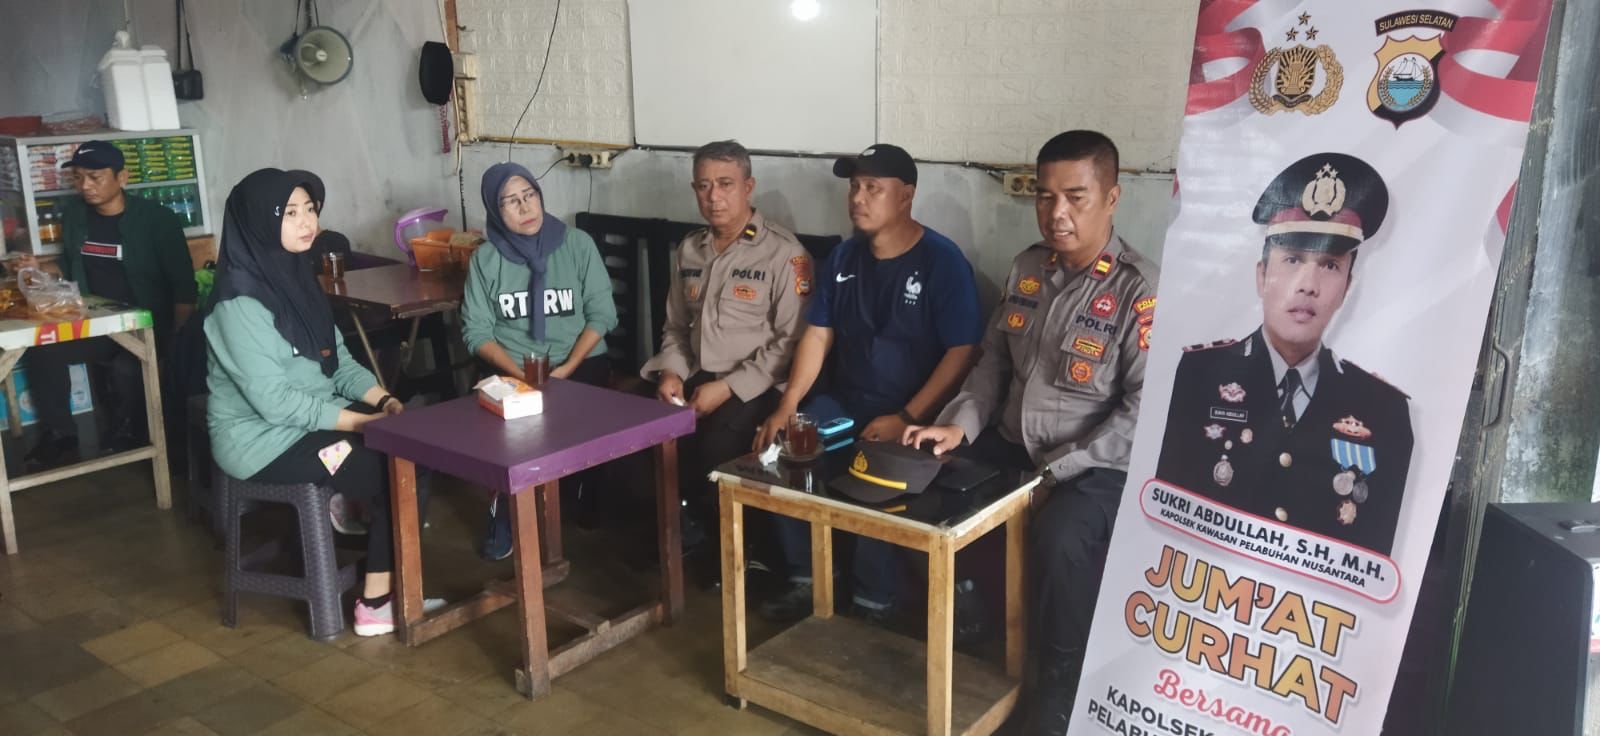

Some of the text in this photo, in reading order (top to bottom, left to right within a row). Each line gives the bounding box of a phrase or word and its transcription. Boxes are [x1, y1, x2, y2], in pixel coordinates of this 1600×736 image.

[1379, 14, 1454, 31] SULAWESI SELATAN
[731, 268, 766, 282] POLRI
[499, 288, 573, 319] RT RW
[1075, 315, 1118, 336] POLRI
[1151, 487, 1191, 515] SUKRI
[1194, 504, 1289, 549] ABDULLAH,
[1342, 553, 1386, 582] M.H.
[1160, 507, 1366, 588] KAPOLSEK KAWASAN PELABUHAN NUSANTARA
[1124, 590, 1358, 724] CURHAT
[1087, 698, 1158, 736] PELAB
[1153, 668, 1292, 736] Bersama
